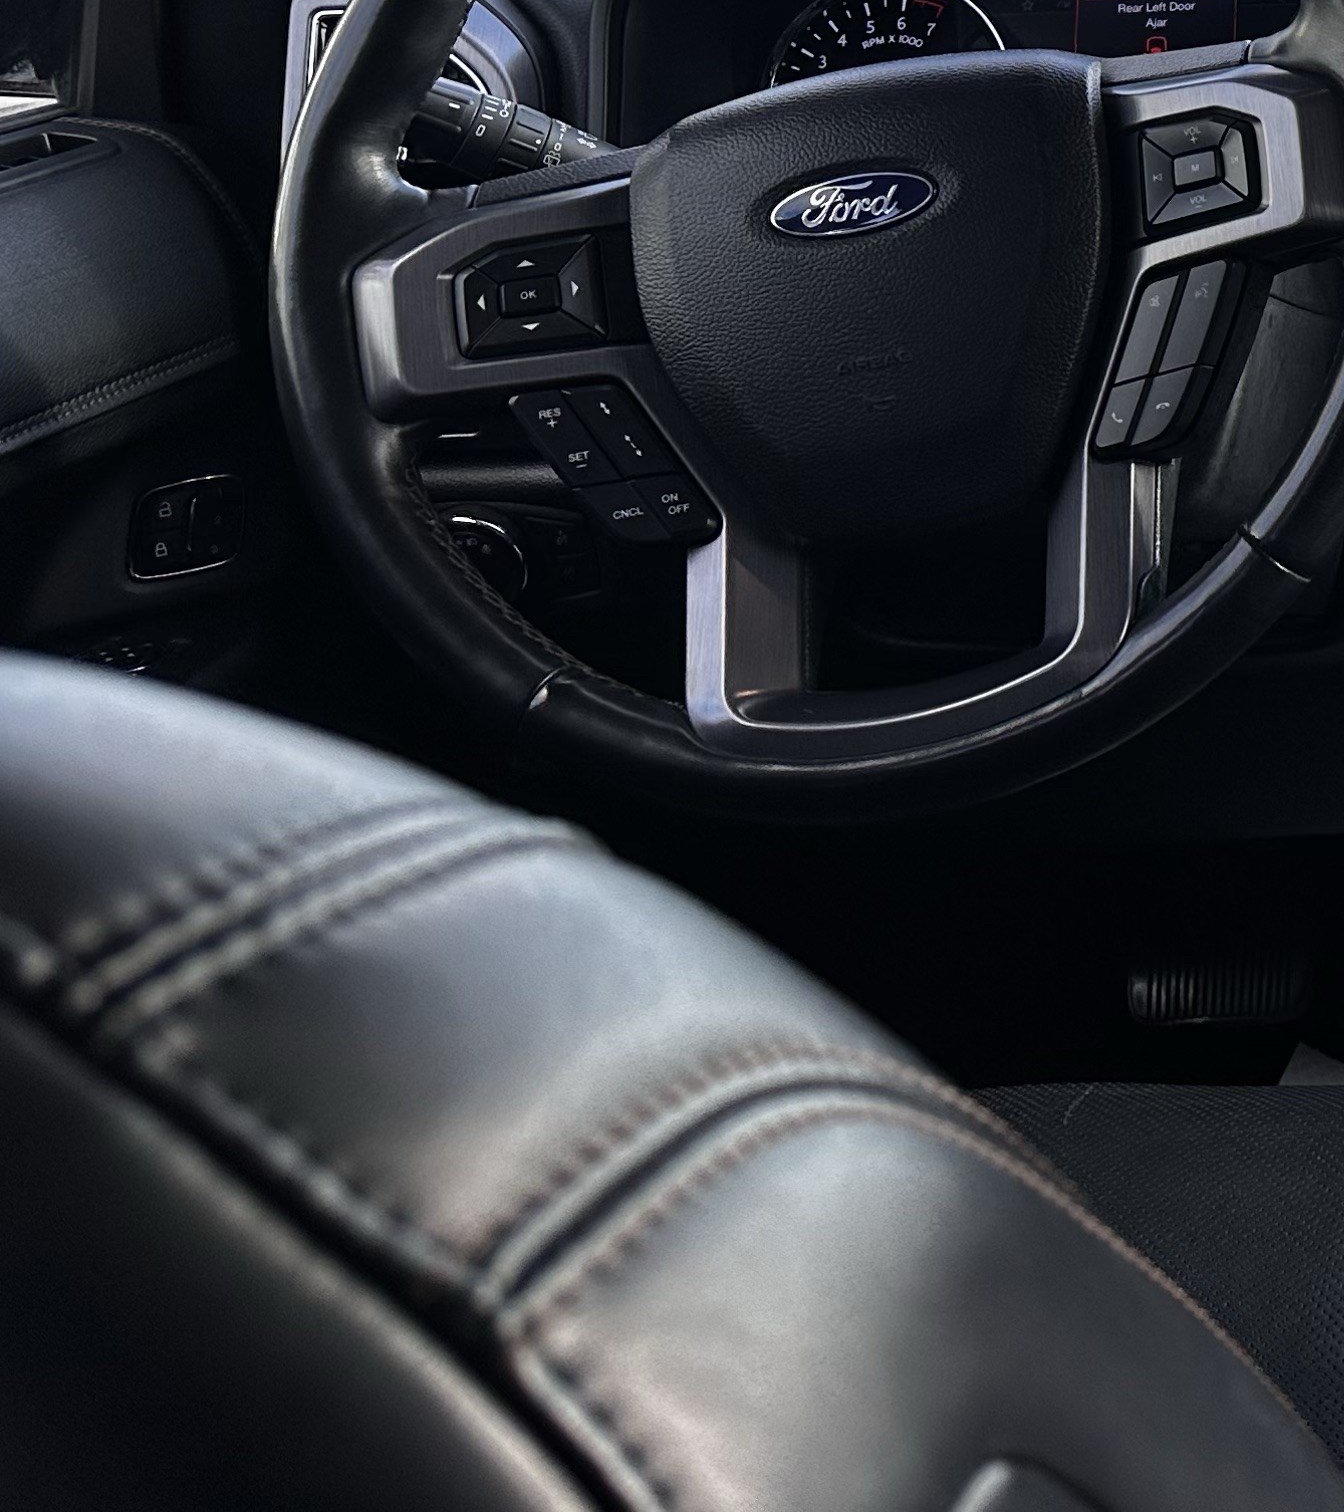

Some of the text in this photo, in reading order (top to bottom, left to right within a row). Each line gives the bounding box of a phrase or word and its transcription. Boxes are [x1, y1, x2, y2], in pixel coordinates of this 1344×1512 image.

[1117, 0, 1196, 14] Rear Left Door
[866, 20, 875, 34] 5
[897, 17, 906, 30] 6
[927, 23, 937, 36] 7
[1145, 17, 1168, 29] Ajar
[837, 34, 848, 47] 4
[861, 36, 885, 49] RPM
[898, 34, 924, 48] 1000
[818, 55, 827, 68] 3
[1184, 127, 1201, 137] VOL
[801, 180, 902, 228] Ford
[1190, 195, 1207, 205] VOL
[520, 290, 537, 300] OK
[538, 407, 562, 419] RES
[568, 450, 590, 462] SET
[661, 492, 679, 503] ON
[612, 506, 644, 520] CNCL
[668, 503, 690, 515] OFF
